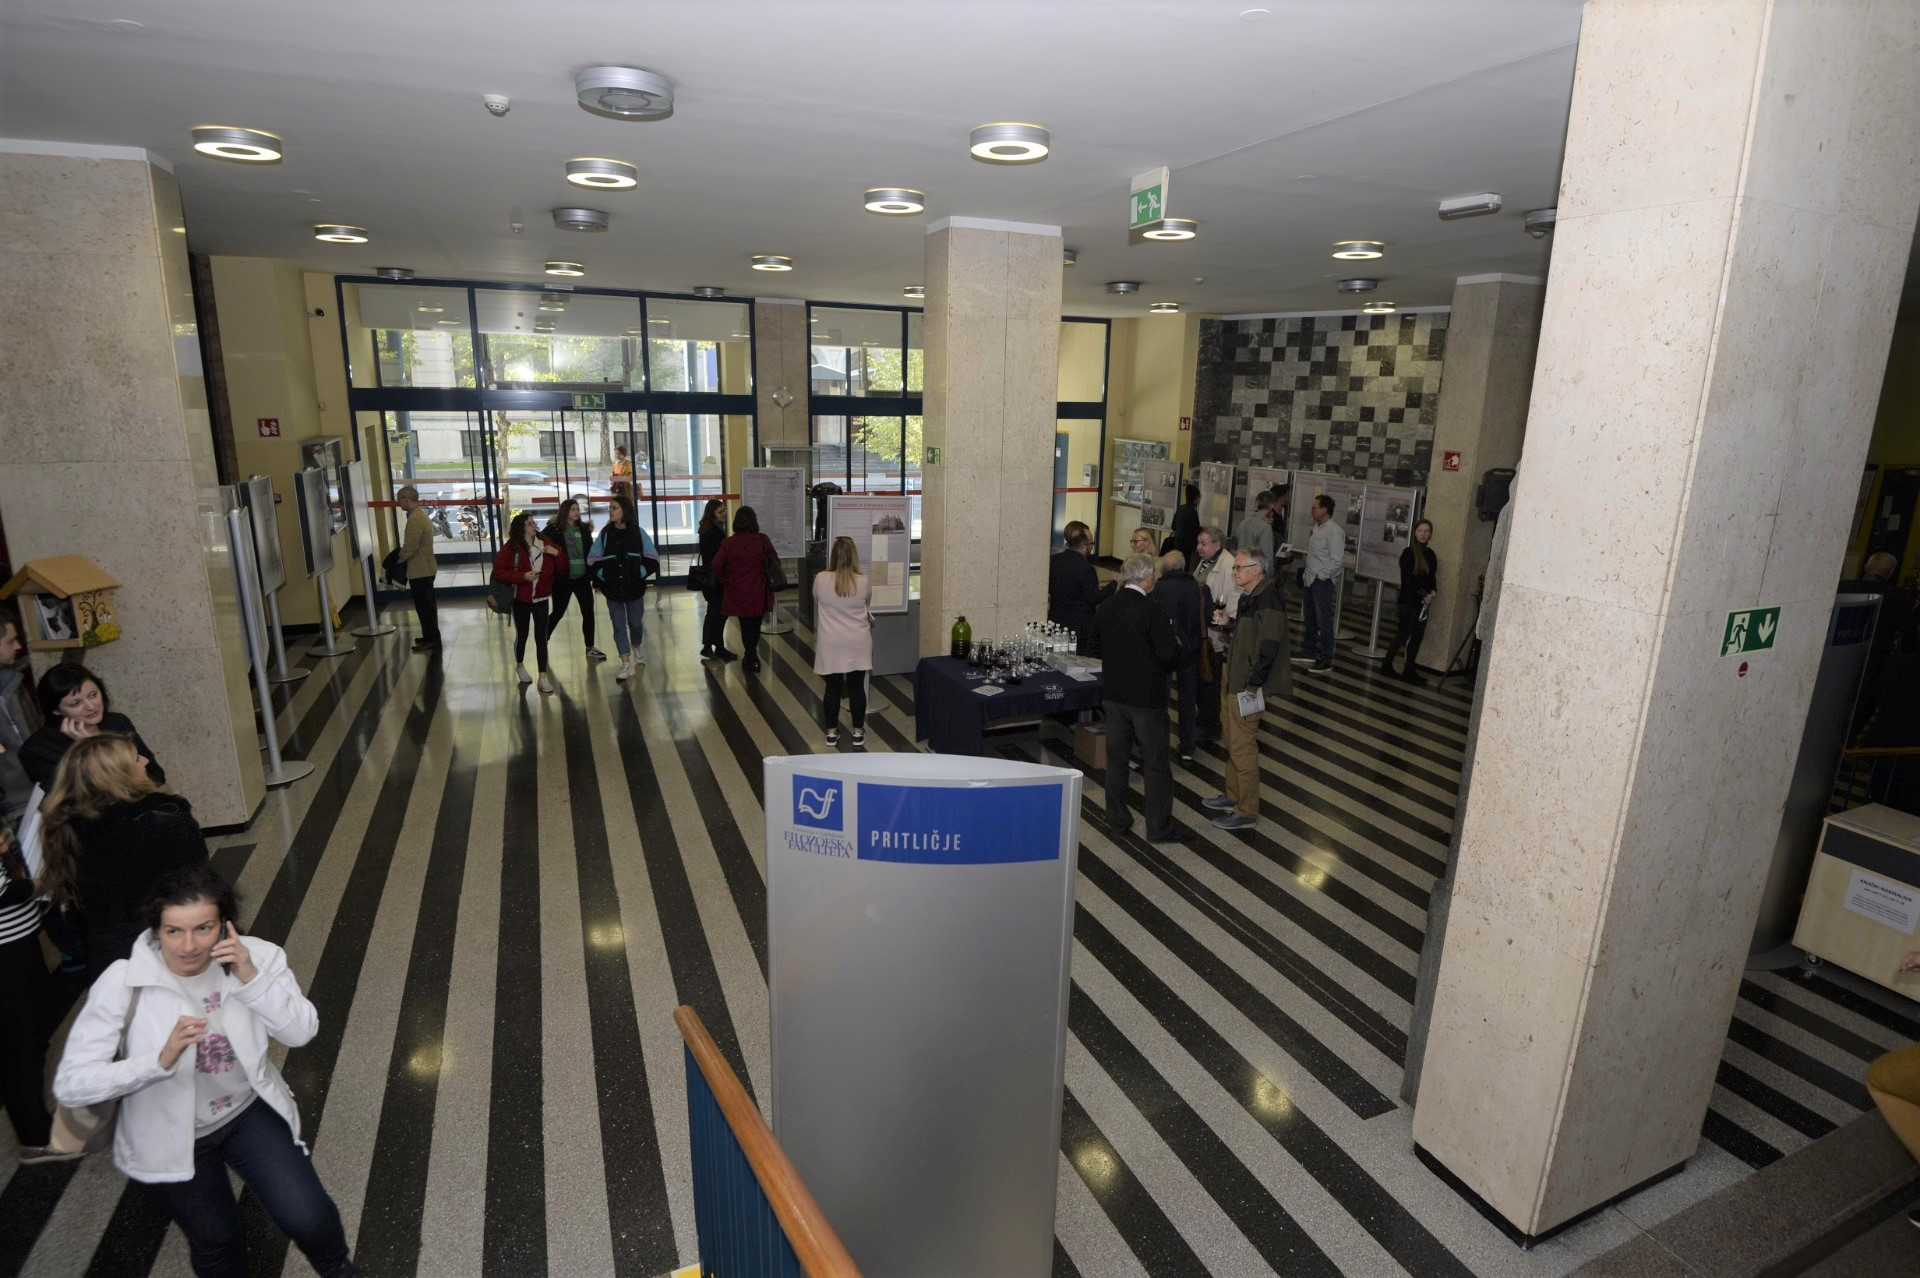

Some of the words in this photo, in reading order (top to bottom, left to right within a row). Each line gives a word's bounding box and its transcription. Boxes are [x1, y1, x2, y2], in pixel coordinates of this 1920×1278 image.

[784, 831, 853, 850] FILOZOFSKA
[788, 840, 850, 858] FAKULTETA
[871, 830, 961, 851] PRITLIČJE
